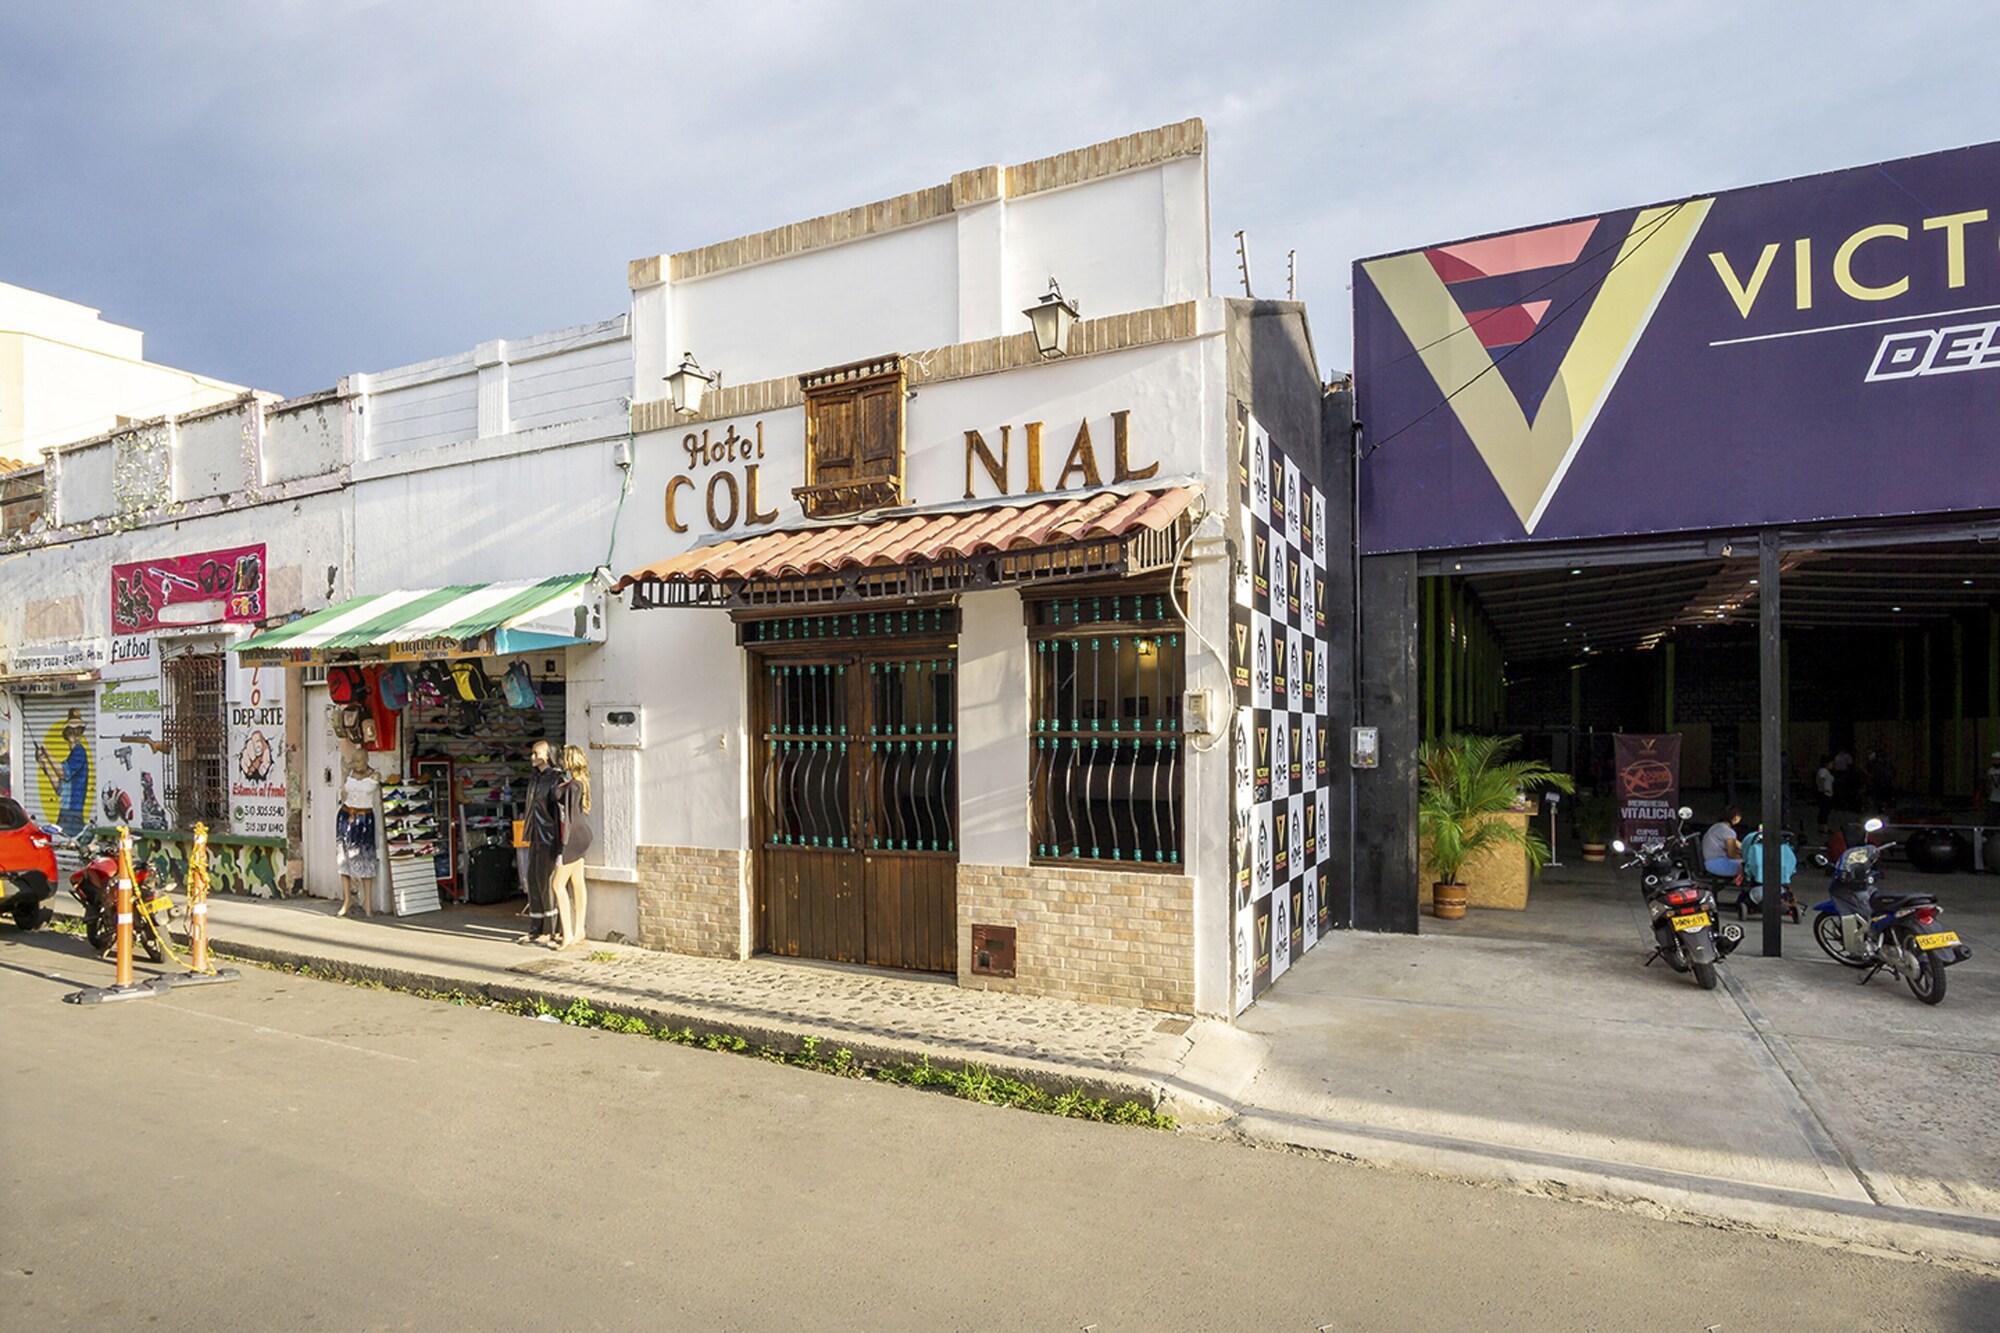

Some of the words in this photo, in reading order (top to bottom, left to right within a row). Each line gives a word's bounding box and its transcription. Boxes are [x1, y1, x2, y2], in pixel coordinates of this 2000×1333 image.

[1708, 209, 2000, 320] VICT
[665, 464, 778, 534] COL
[964, 410, 1160, 499] NIAL
[682, 421, 765, 469] Hotel
[1621, 808, 1677, 820] VITALICIA
